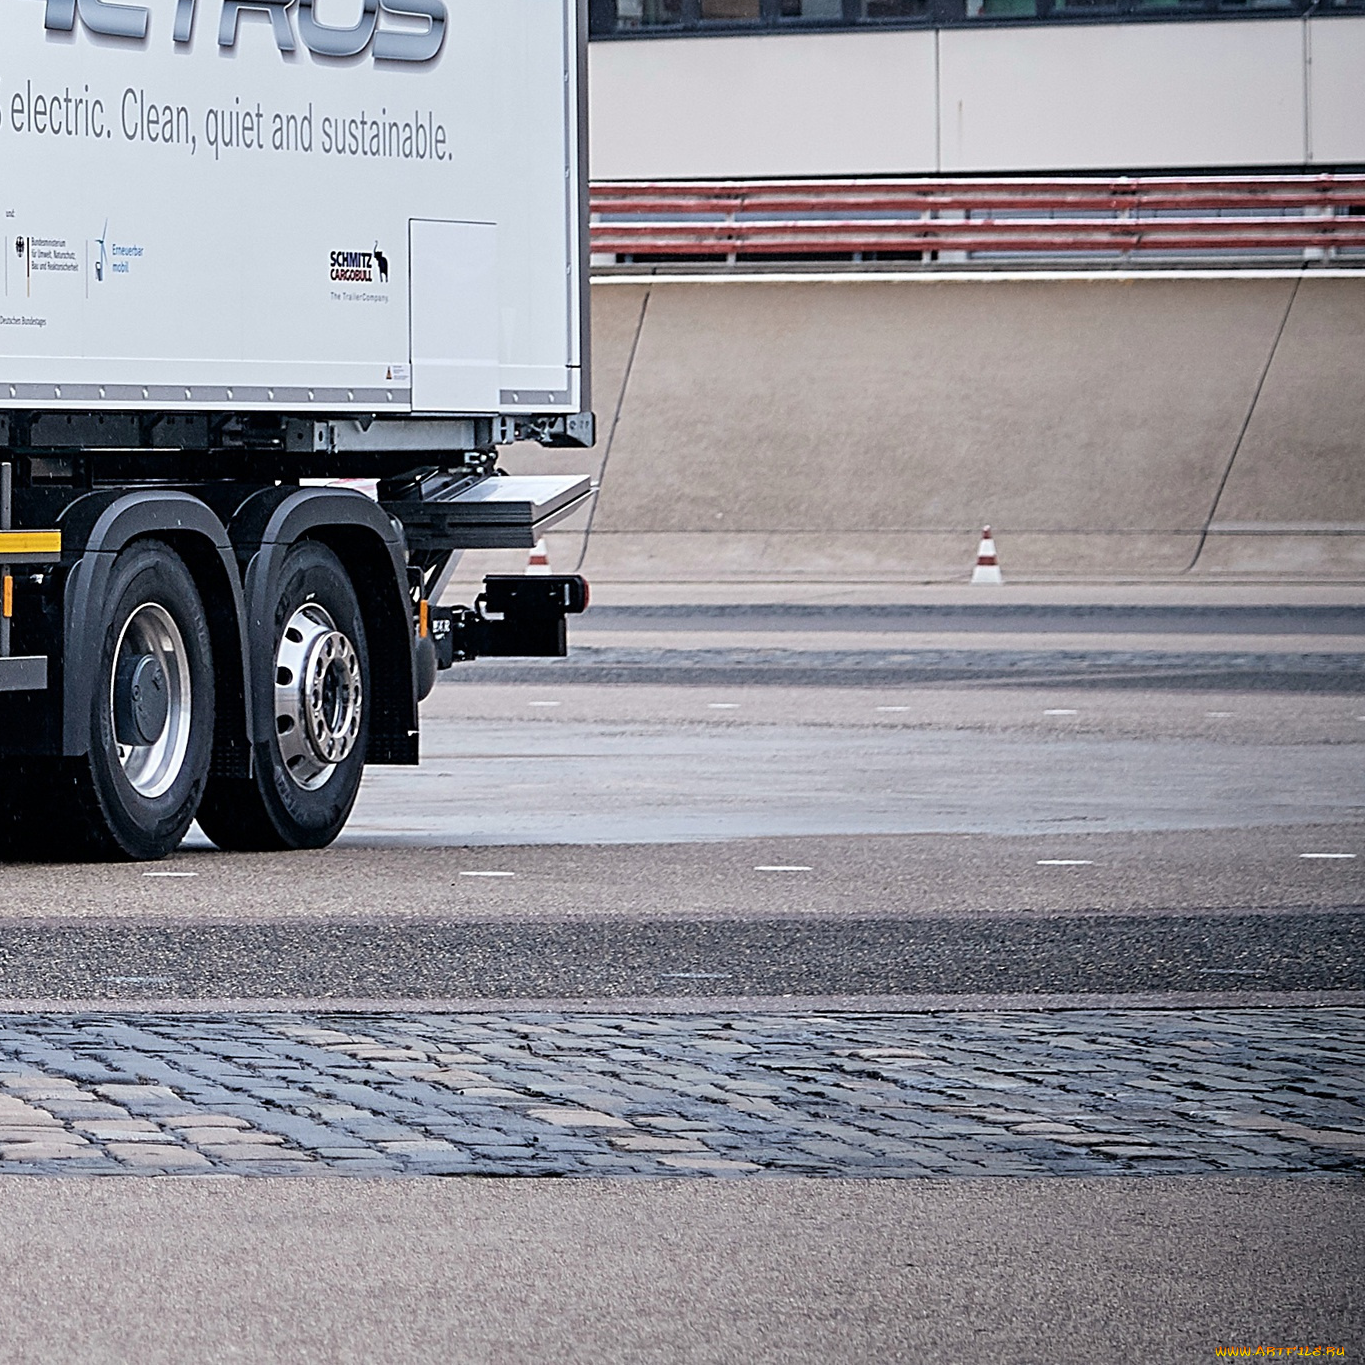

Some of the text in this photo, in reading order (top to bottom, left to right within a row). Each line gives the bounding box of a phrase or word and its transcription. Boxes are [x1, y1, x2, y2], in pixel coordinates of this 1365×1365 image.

[10, 79, 111, 139] electric.
[121, 87, 197, 155] Clean,
[206, 96, 264, 161] quiet
[272, 102, 313, 153] and
[321, 107, 453, 161] sustainable.
[112, 244, 144, 257] Erneuerbar
[330, 251, 373, 269] SCHMITZ
[112, 261, 129, 273] mobil
[330, 269, 373, 282] CARGOBULL
[330, 291, 341, 301] The
